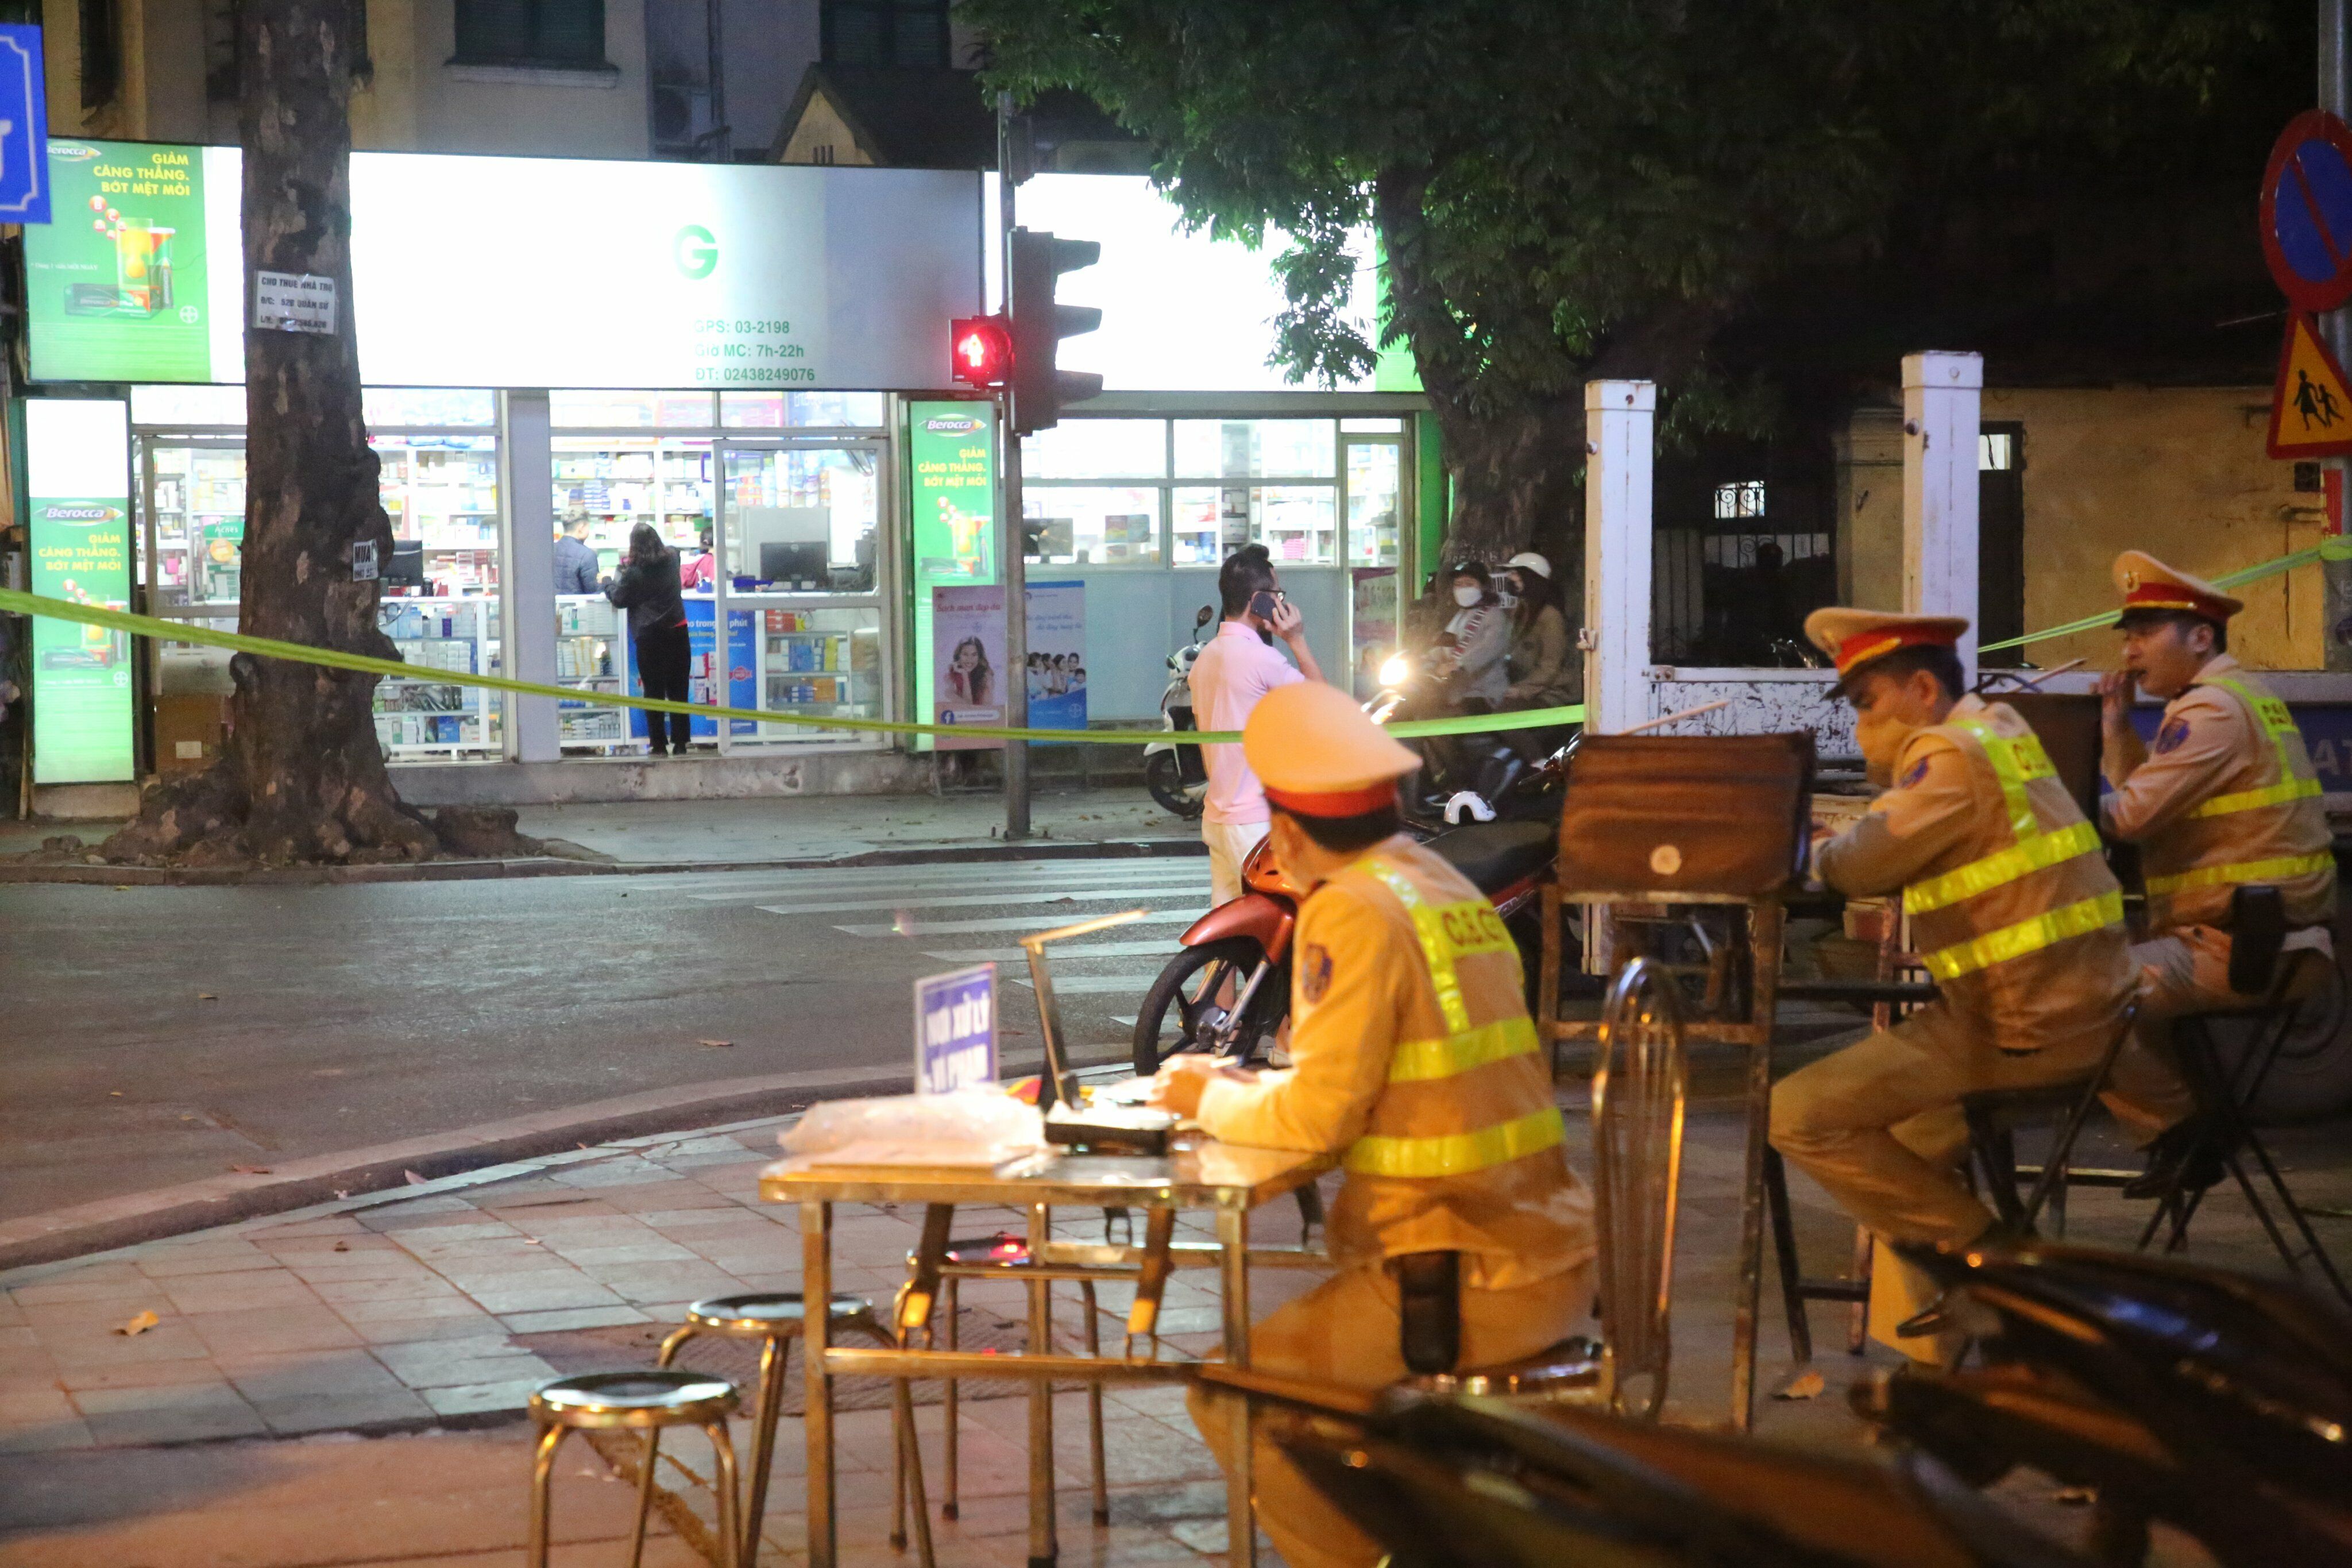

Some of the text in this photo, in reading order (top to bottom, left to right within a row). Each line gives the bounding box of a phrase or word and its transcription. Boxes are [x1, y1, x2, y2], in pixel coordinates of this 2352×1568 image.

[673, 225, 718, 280] G
[261, 277, 277, 286] CHO
[695, 320, 790, 333] GPS: 03-2198
[724, 344, 751, 357] MC:
[756, 345, 804, 357] 7h-22h
[724, 368, 815, 381] 02438249076
[928, 420, 972, 430] Berocca
[47, 508, 105, 517] Berocca
